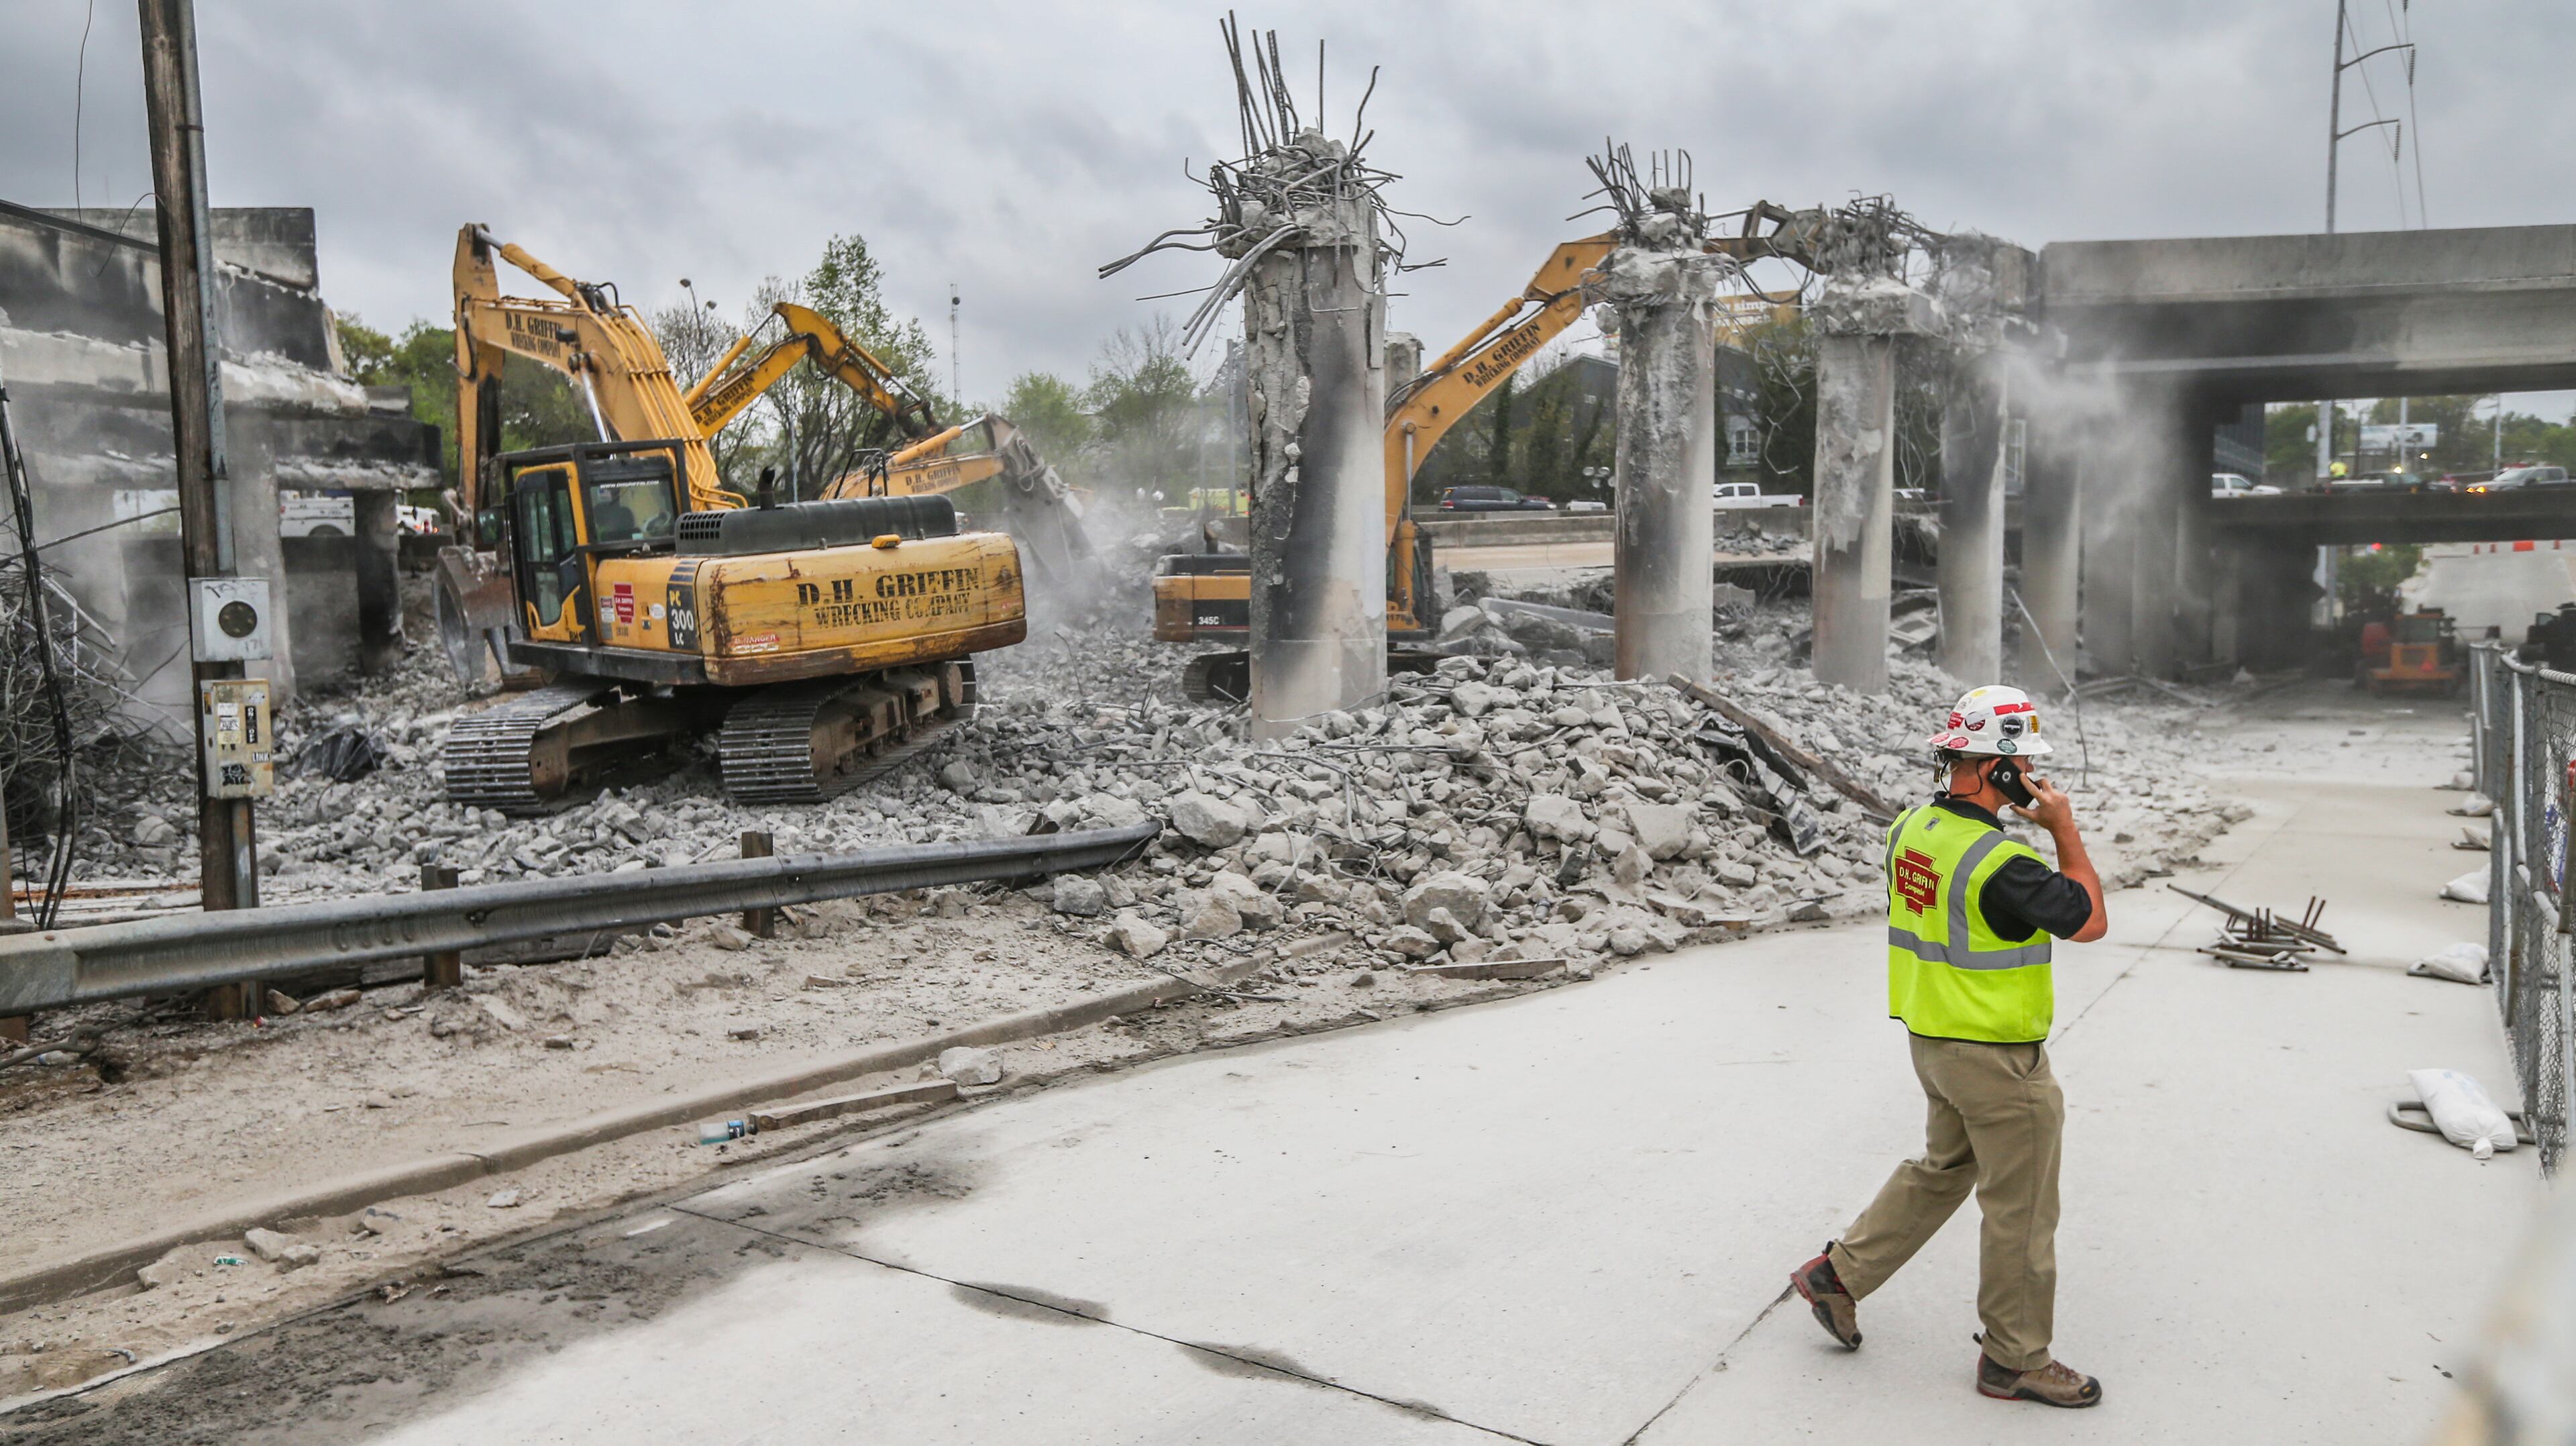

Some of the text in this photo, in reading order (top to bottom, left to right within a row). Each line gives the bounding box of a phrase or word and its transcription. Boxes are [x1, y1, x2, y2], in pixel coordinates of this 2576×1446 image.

[506, 311, 525, 332] D.H.
[1463, 321, 1541, 384] D.H. GRIFFIN
[1474, 360, 1511, 387] WRECKING
[716, 377, 755, 405] GRIFFIN
[906, 465, 961, 486] D.H. GRIFFIN
[797, 567, 979, 605] D.H. GRIFFIN
[669, 590, 682, 607] PC
[672, 609, 695, 631] 300
[814, 592, 971, 629] WRECKING COMPANY
[1198, 616, 1220, 625] 345C
[675, 632, 684, 645] LC
